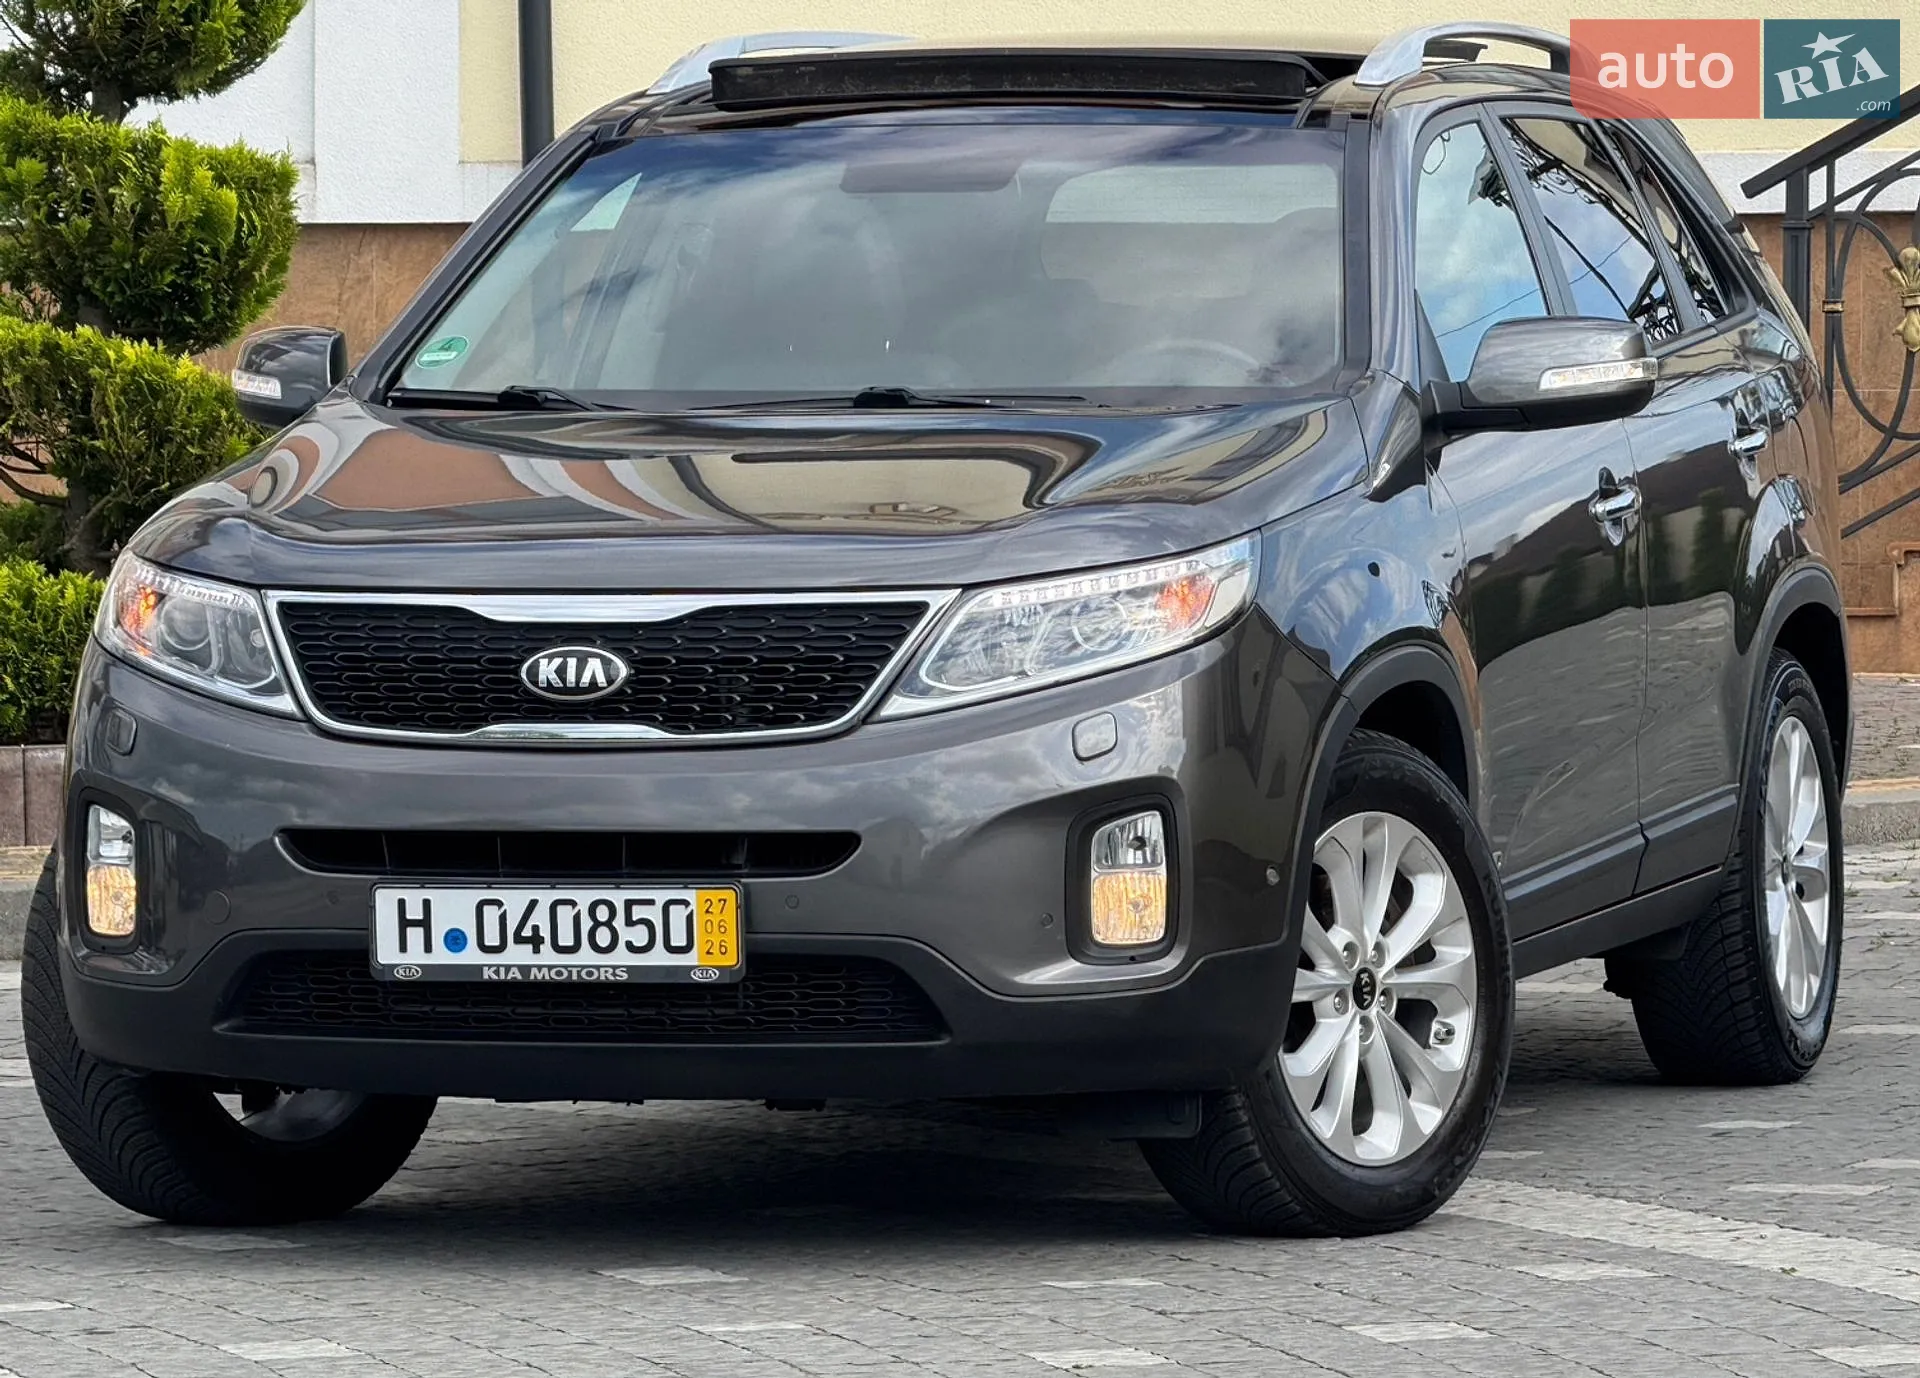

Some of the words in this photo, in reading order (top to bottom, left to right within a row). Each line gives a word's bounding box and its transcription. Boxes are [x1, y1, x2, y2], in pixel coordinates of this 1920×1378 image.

[538, 657, 608, 688] KIA
[704, 898, 727, 914] 27
[397, 898, 433, 954] H
[475, 898, 695, 955] 040850
[704, 918, 727, 934] 06
[705, 939, 728, 955] 26
[482, 966, 522, 980] KIA
[529, 967, 629, 981] MOTORS
[1360, 972, 1371, 1006] KIA
